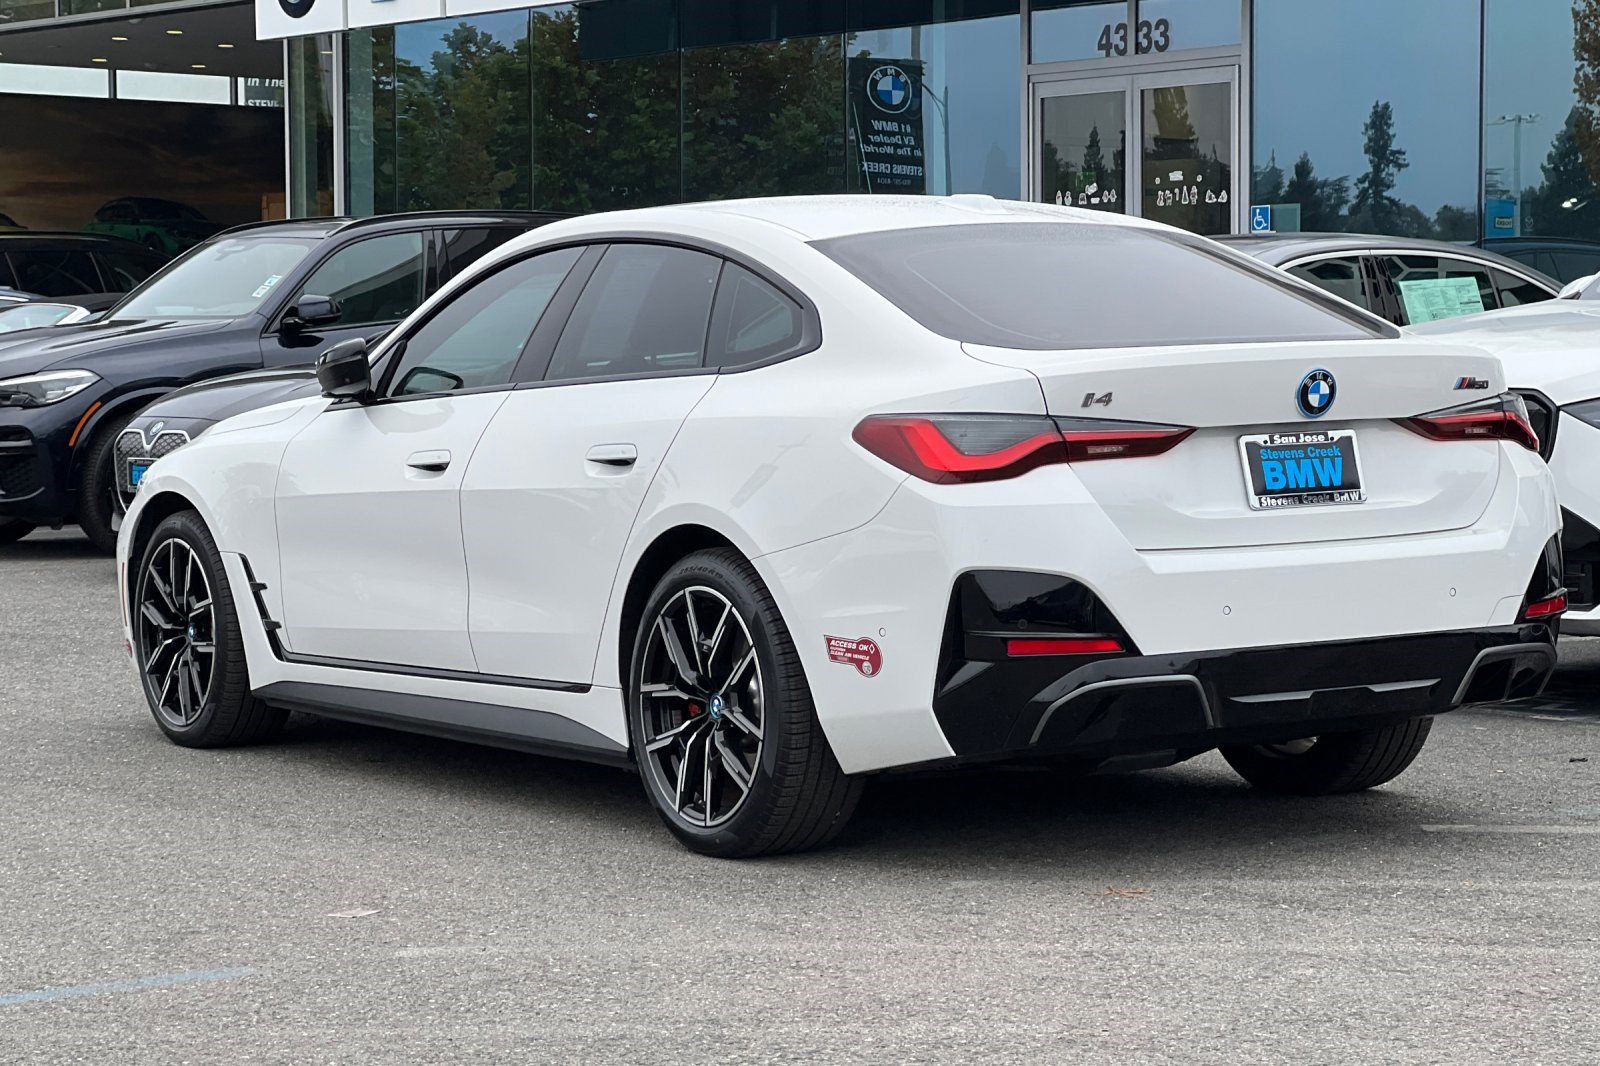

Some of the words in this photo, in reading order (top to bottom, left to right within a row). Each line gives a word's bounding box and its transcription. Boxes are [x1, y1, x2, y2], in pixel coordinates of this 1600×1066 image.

[1097, 17, 1170, 57] 4333
[1081, 391, 1113, 408] i4
[1272, 434, 1297, 445] San
[1299, 432, 1326, 443] Jose
[1260, 447, 1305, 460] Stevens
[1307, 445, 1342, 458] Creek
[1261, 457, 1343, 491] BMW
[1260, 494, 1300, 507] Stevens
[1301, 492, 1331, 504] Creek
[1333, 491, 1360, 503] BMW
[830, 639, 858, 650] ACCESS
[858, 643, 870, 652] OK
[830, 649, 844, 657] CLEAN
[852, 653, 870, 661] VEHICLE
